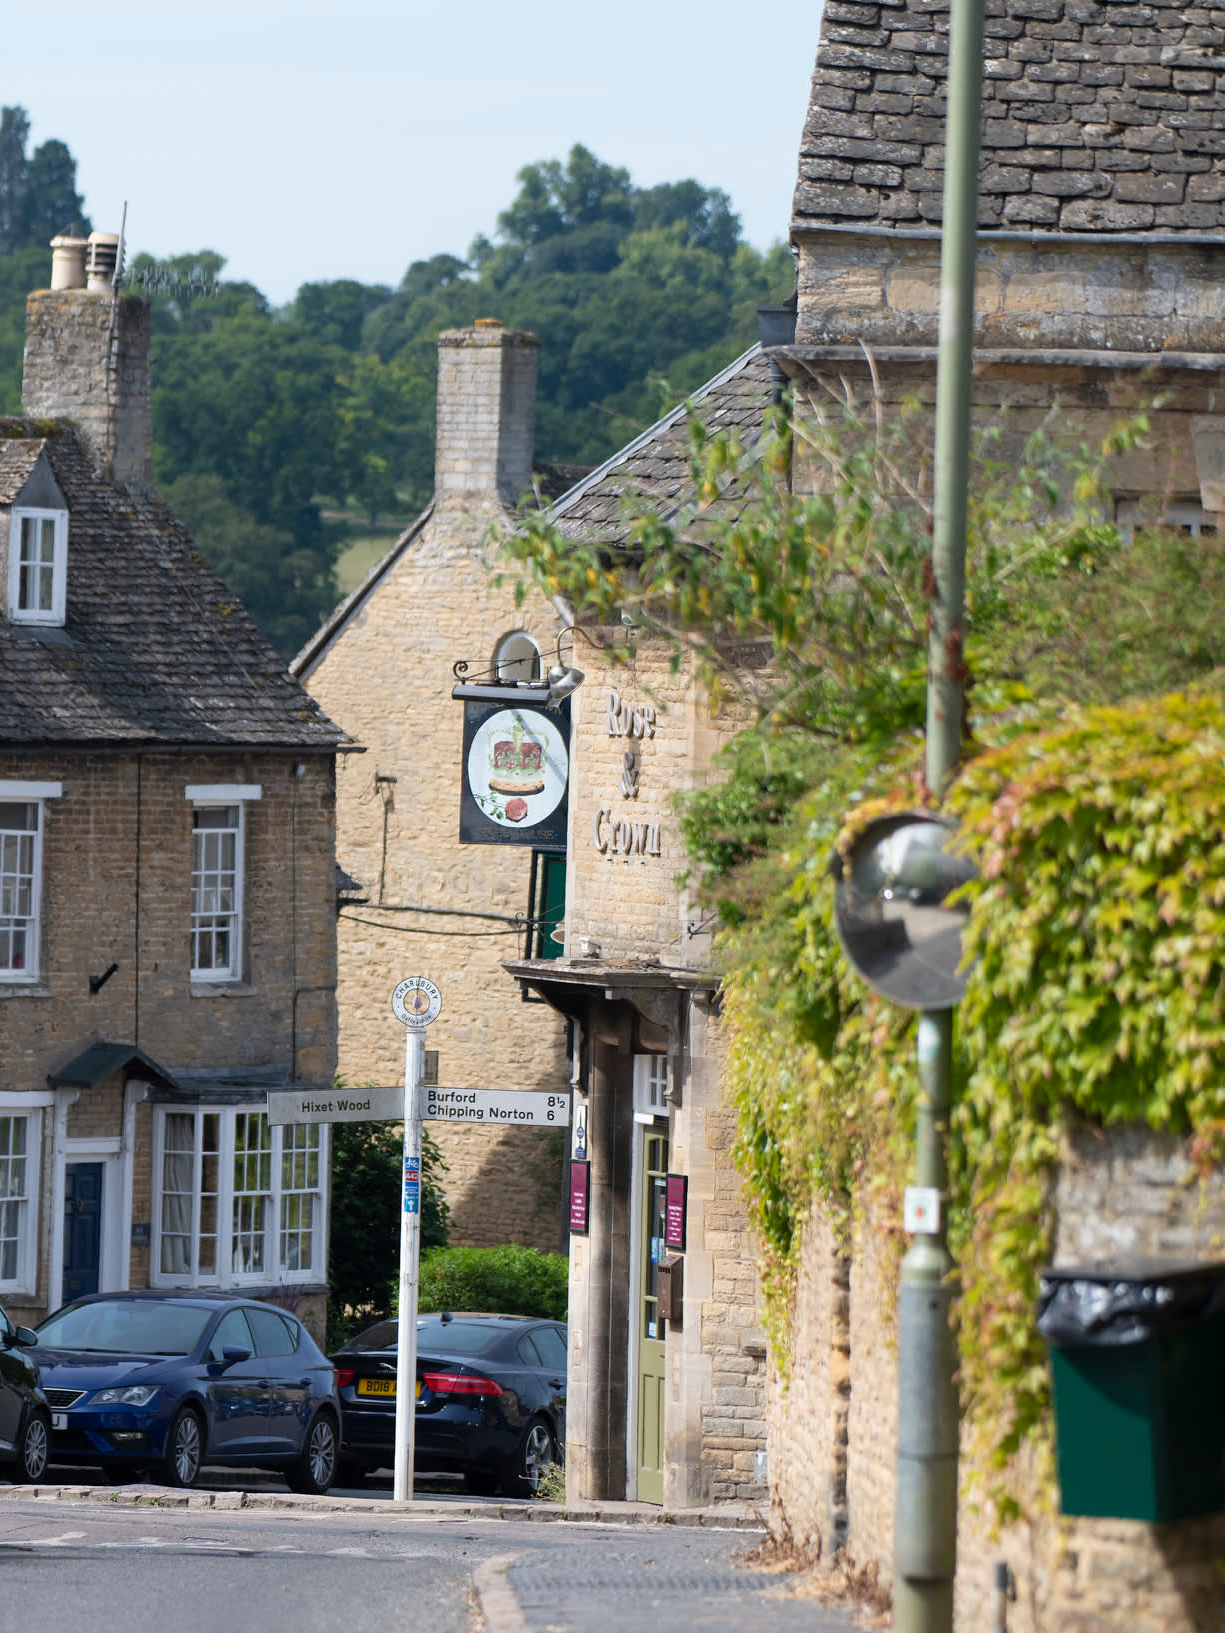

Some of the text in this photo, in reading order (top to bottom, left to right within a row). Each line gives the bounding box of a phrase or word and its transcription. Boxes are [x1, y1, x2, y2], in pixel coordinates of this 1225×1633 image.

[607, 692, 656, 739] Rose
[619, 751, 639, 799] &
[592, 808, 661, 857] Crown
[395, 979, 439, 999] CHARLBURY
[301, 1099, 371, 1113] Hixet Wood
[427, 1090, 476, 1103] Burford
[427, 1104, 555, 1121] Chipping Norton 6
